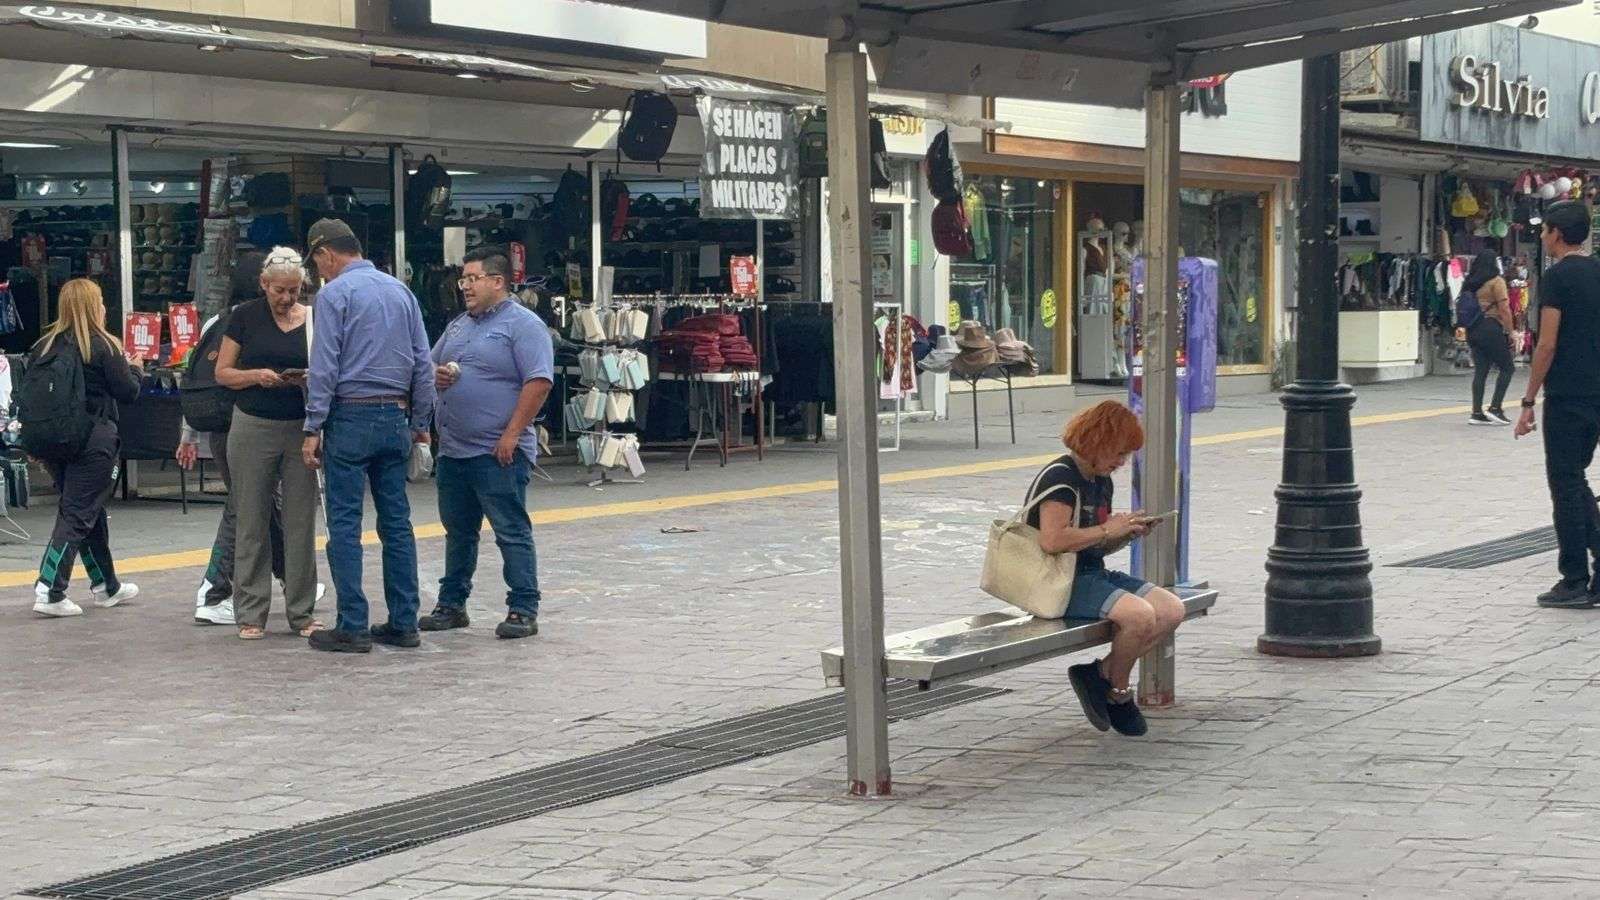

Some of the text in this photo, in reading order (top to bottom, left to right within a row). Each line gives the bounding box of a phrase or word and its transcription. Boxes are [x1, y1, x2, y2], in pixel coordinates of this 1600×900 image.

[1457, 54, 1550, 119] Silvia
[720, 143, 777, 175] PLACAS
[711, 179, 788, 213] MILITARES
